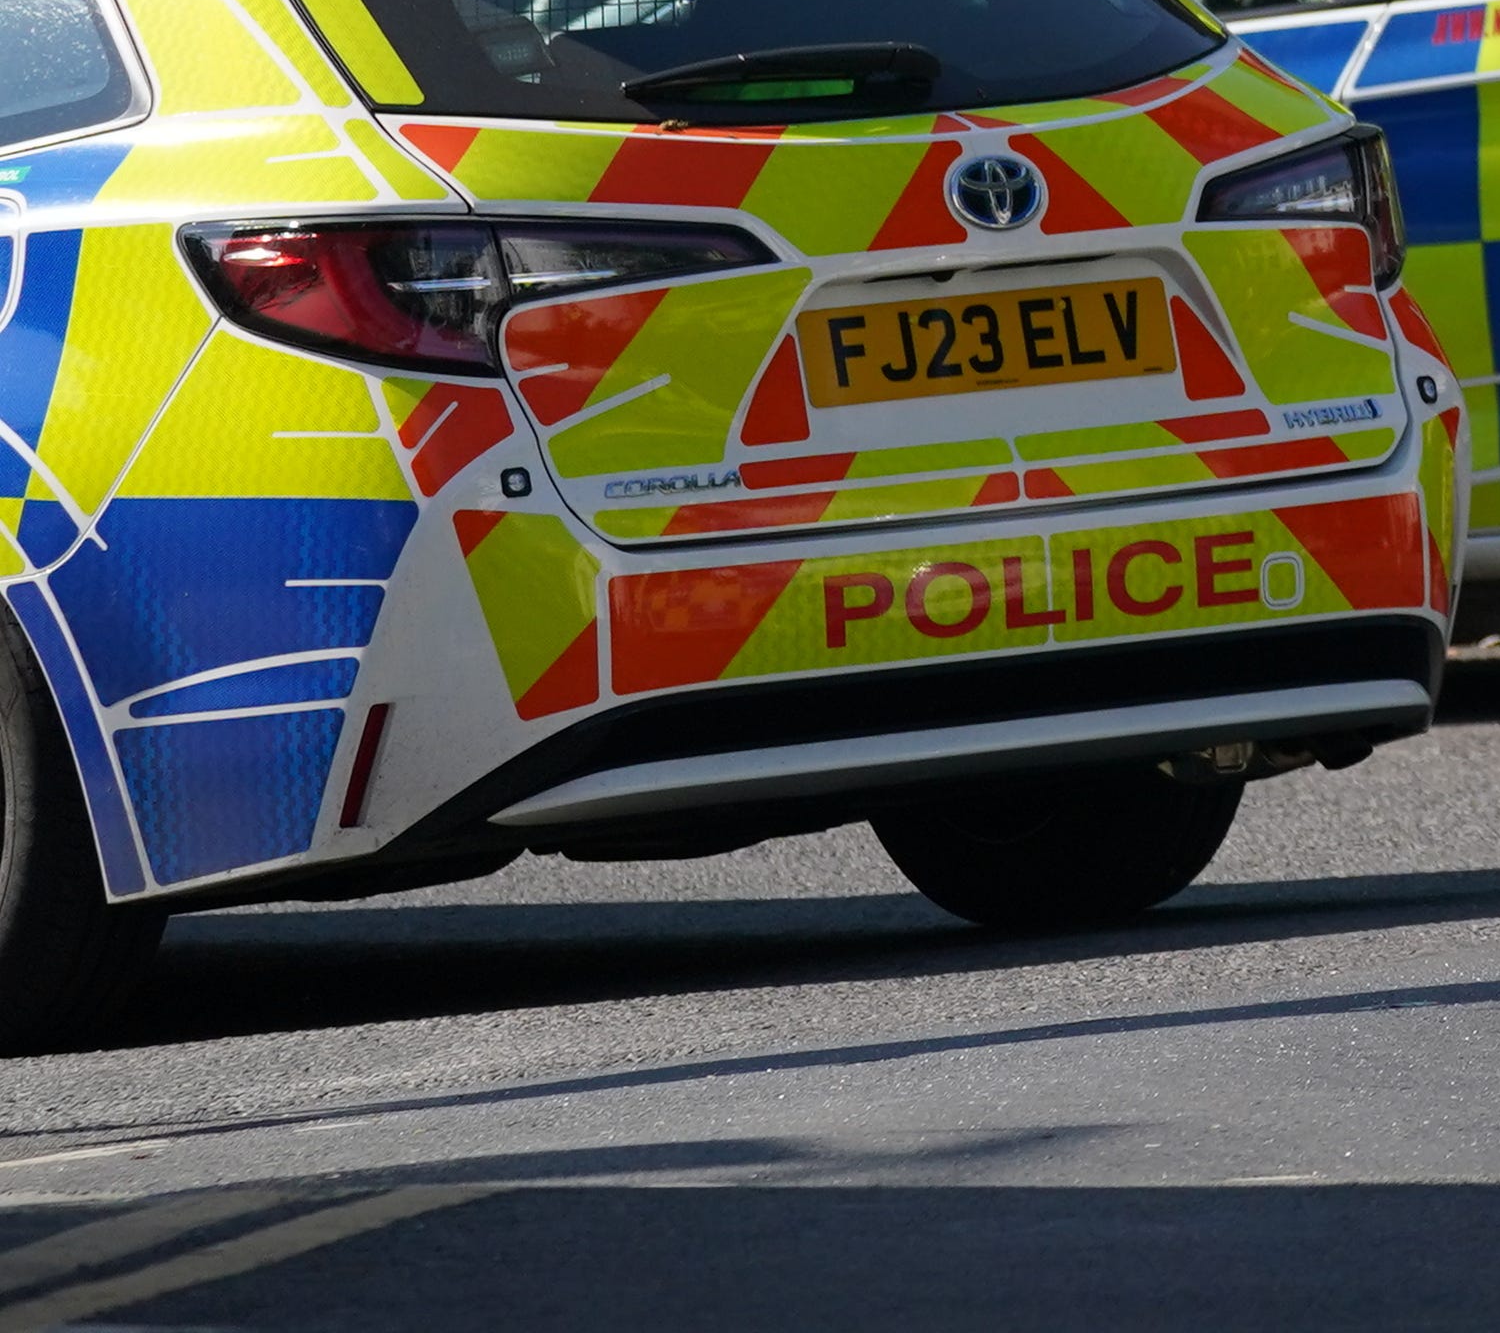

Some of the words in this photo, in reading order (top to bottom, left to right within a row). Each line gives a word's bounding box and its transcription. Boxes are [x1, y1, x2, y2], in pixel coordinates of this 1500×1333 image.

[827, 301, 1006, 389] FJ23
[1016, 287, 1142, 372] ELV
[603, 468, 743, 500] COROLLA
[823, 530, 1260, 650] POLICE
